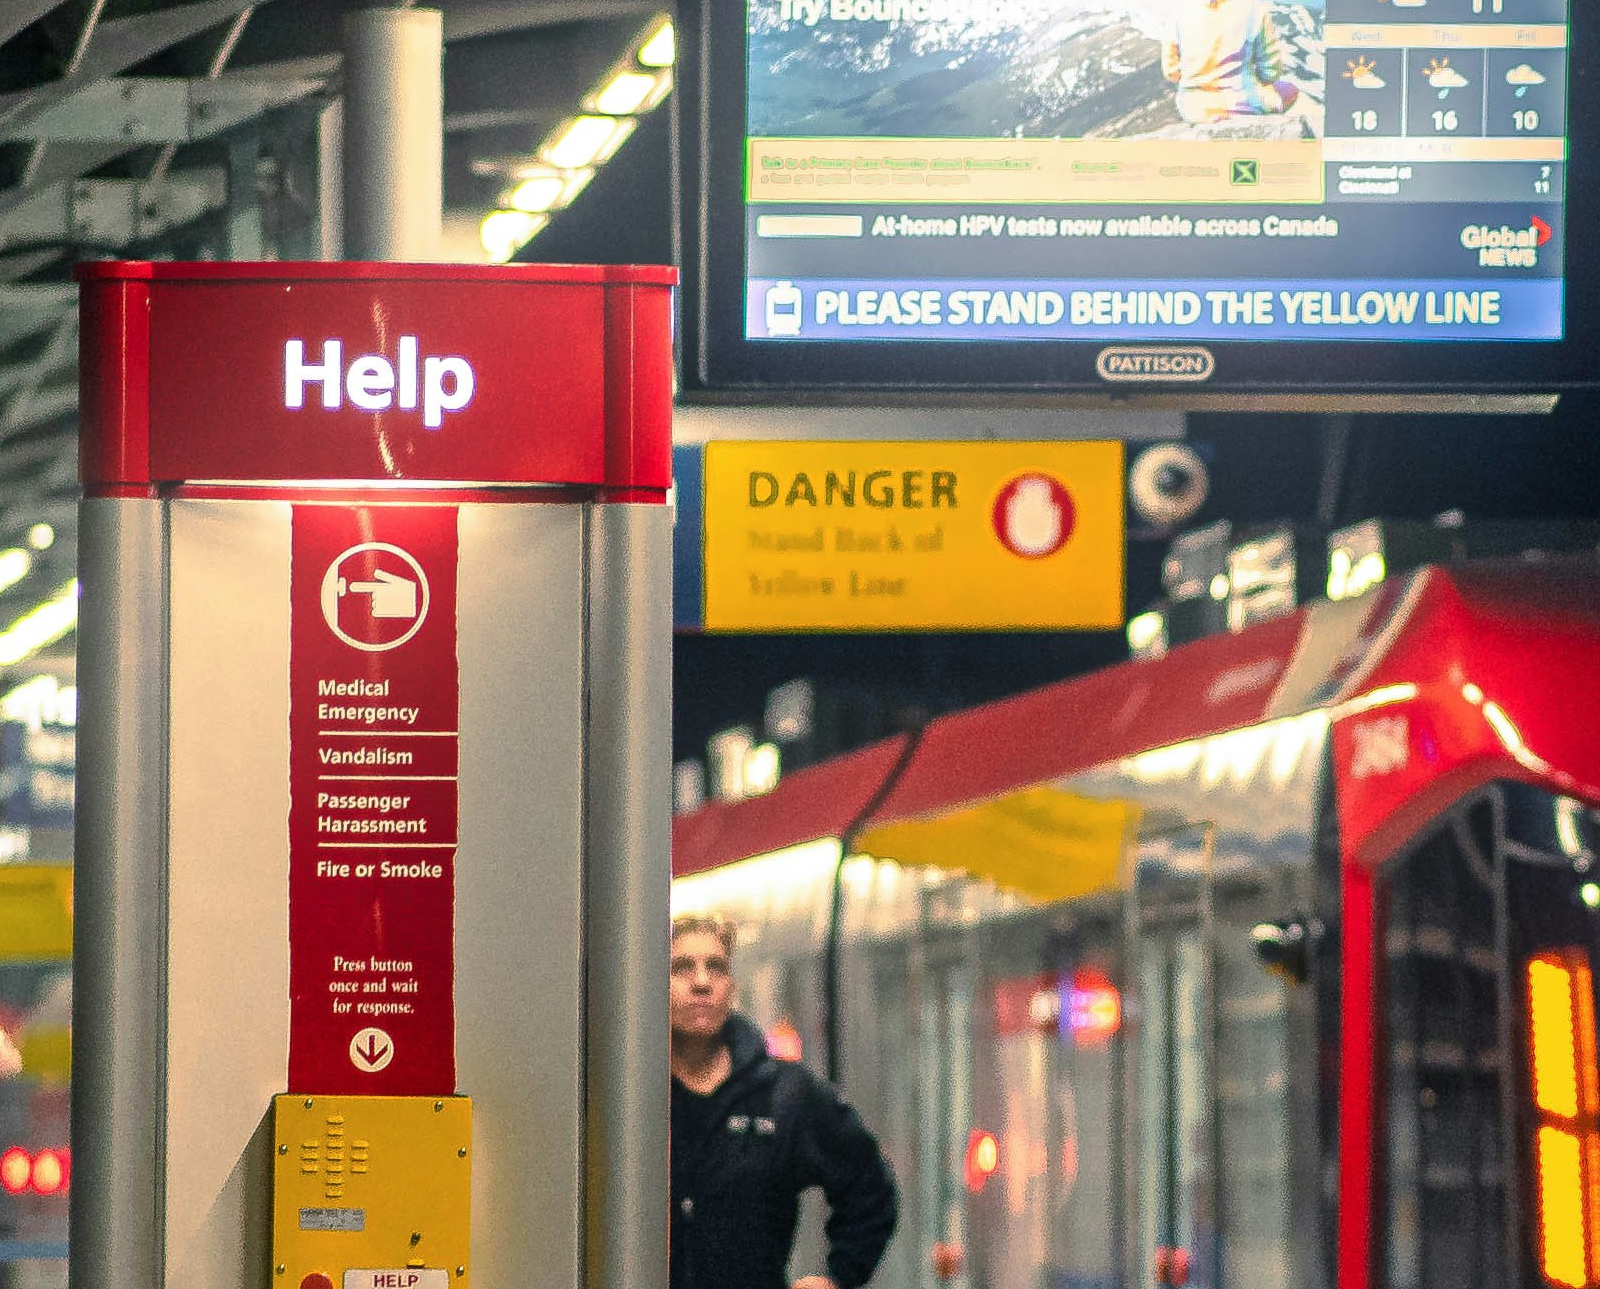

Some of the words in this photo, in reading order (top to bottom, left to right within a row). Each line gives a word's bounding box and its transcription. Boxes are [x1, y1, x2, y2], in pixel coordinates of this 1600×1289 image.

[1352, 110, 1378, 131] 18
[1432, 110, 1458, 131] 16
[1513, 110, 1539, 131] 10
[872, 215, 956, 237] At-home
[959, 215, 1006, 237] HPV
[1007, 216, 1058, 237] tests
[1060, 219, 1103, 237] now
[1105, 216, 1192, 237] available
[1194, 218, 1261, 237] across
[1262, 216, 1339, 237] Canada
[1460, 224, 1539, 250] Global
[1478, 249, 1538, 268] NEWS
[815, 291, 942, 325] PLEASE
[947, 291, 1064, 326] STAND
[1069, 291, 1202, 326] BEHIND
[1206, 291, 1274, 326] THE
[1278, 291, 1419, 326] YELLOW
[1425, 291, 1501, 326] LINE
[1108, 354, 1204, 373] PATTISON
[283, 337, 476, 428] Help
[747, 470, 959, 509] DANGER
[318, 678, 390, 697] Medical
[318, 703, 419, 724] Emergency
[318, 747, 413, 765] Vandalism
[317, 792, 411, 812] Passenger
[317, 816, 427, 833] Harassment
[316, 860, 350, 878] Fire
[355, 864, 375, 878] or
[380, 860, 443, 878] Smoke
[333, 955, 366, 972] Press
[370, 955, 413, 972] button
[328, 981, 359, 993] once
[363, 976, 387, 993] and
[391, 977, 419, 993] wait
[333, 996, 353, 1014] for
[357, 1001, 415, 1017] response.
[373, 1273, 420, 1288] HELP
